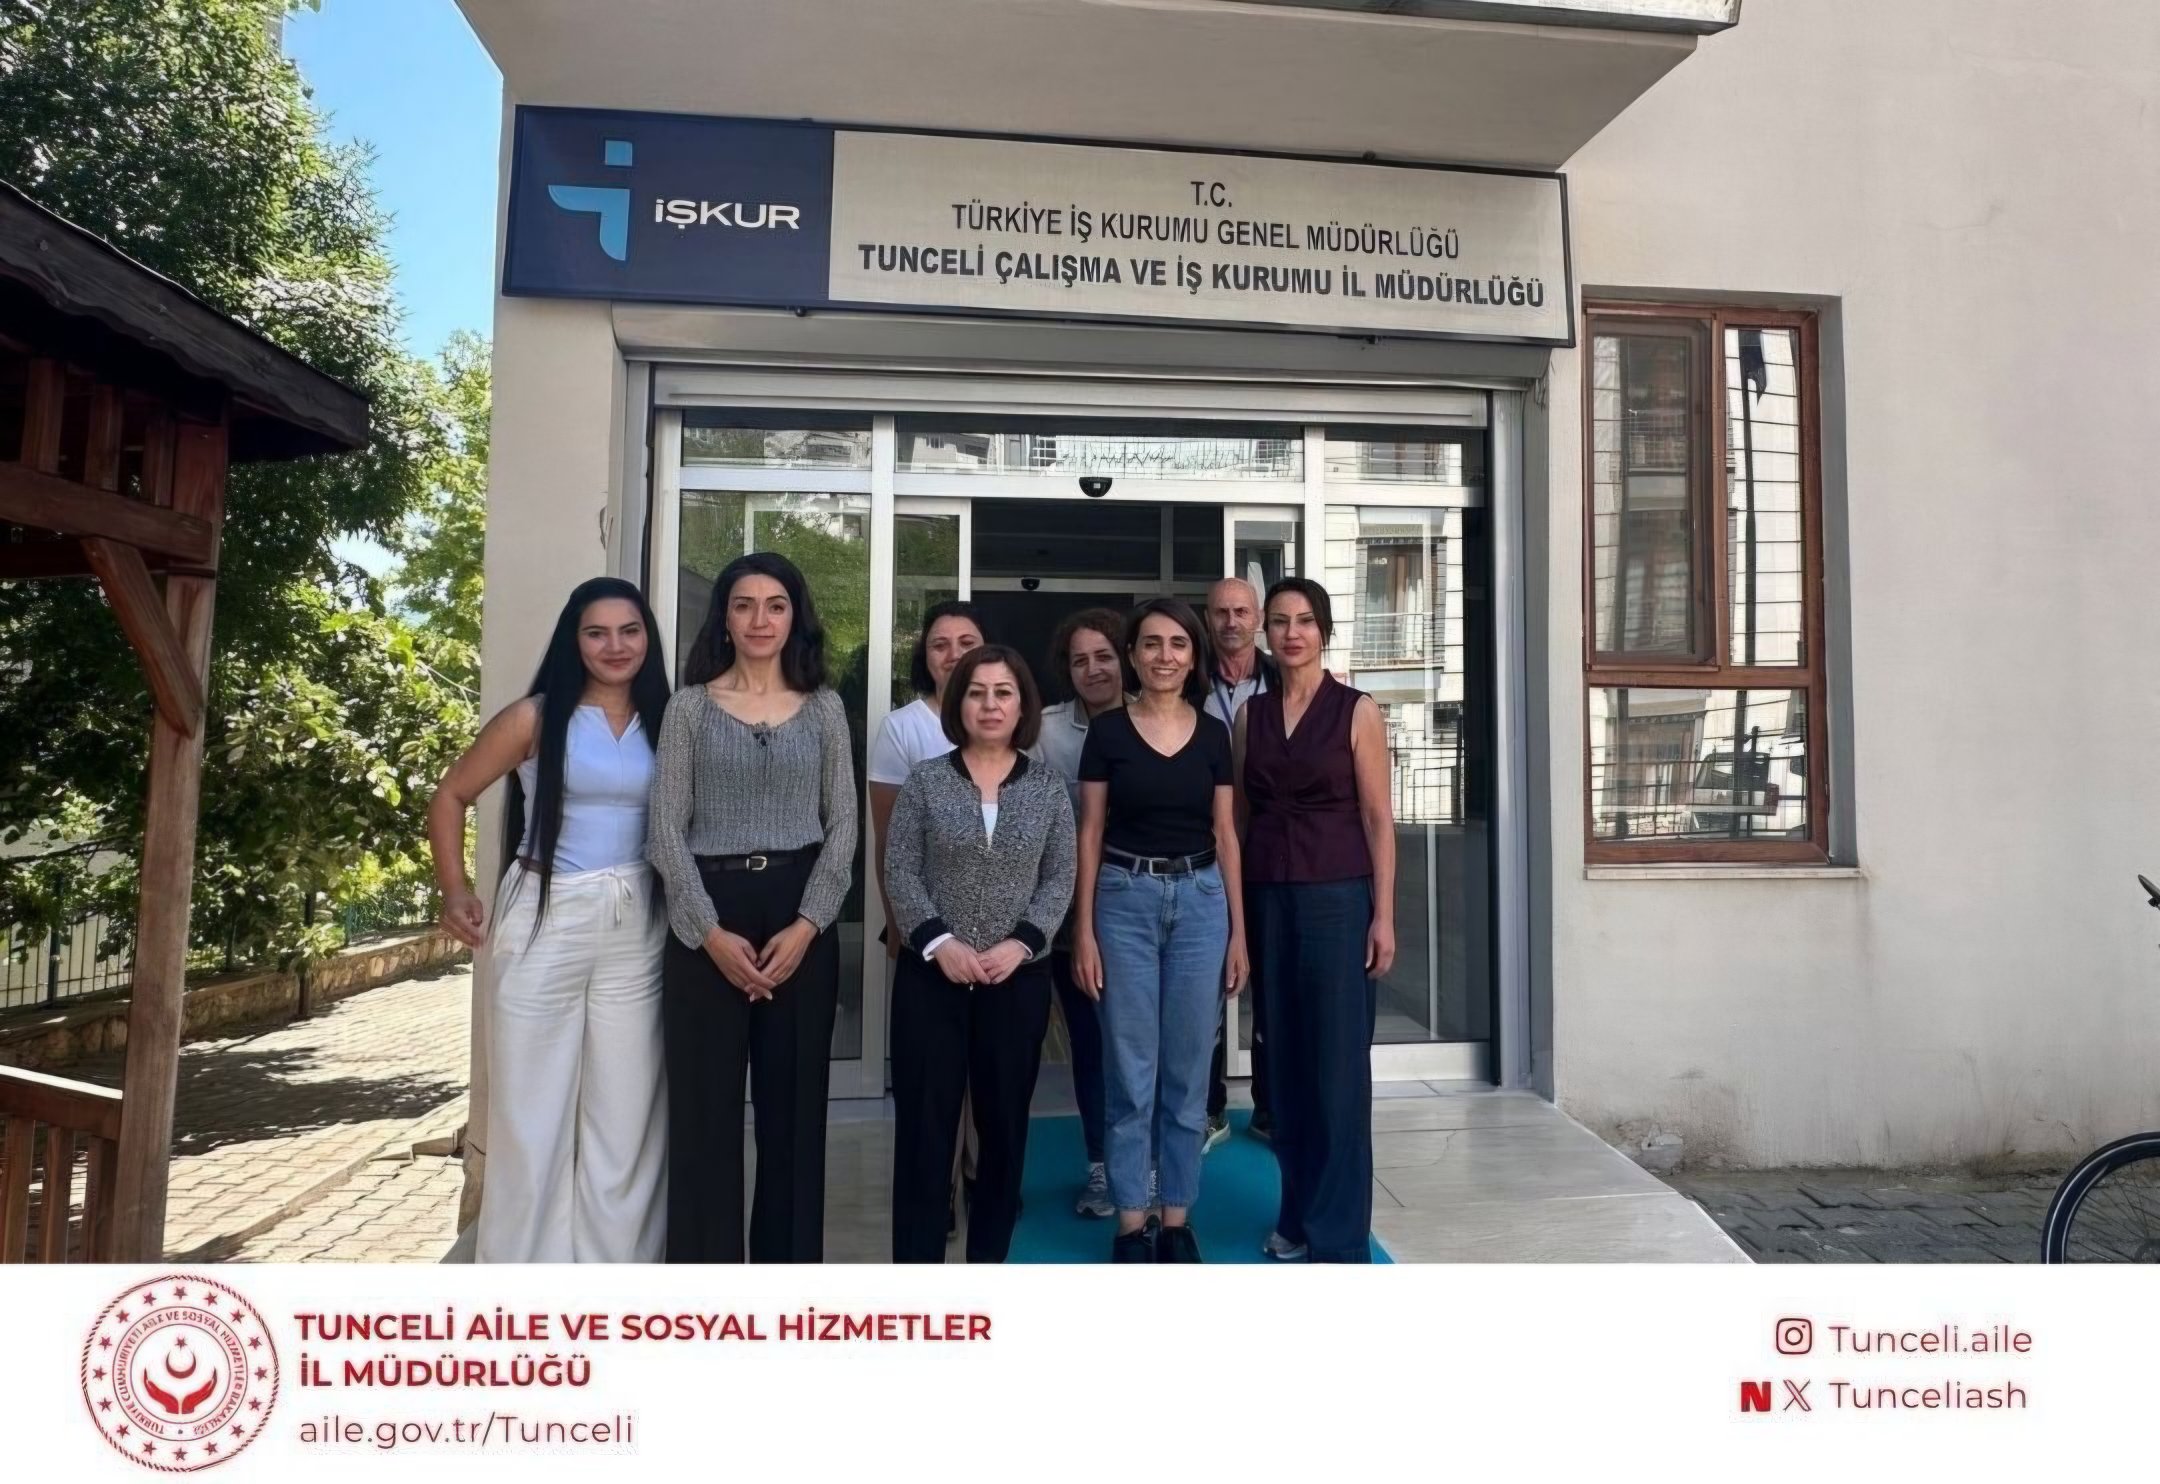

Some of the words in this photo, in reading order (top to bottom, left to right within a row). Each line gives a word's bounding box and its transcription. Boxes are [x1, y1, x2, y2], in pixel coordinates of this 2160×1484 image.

[1190, 180, 1234, 208] T.C.
[952, 198, 1063, 235] TÜRKİYE
[1071, 203, 1093, 243] İŞ
[1102, 212, 1208, 243] KURUMU
[1218, 220, 1300, 249] GENEL
[1307, 220, 1459, 259] MÜDÜRLÜĞÜ
[858, 243, 984, 277] TUNCELİ
[995, 251, 1122, 288] ÇALIŞMA
[1130, 258, 1167, 286] VE
[1177, 254, 1203, 295] İŞ
[1213, 263, 1332, 296] KURUMU
[1343, 264, 1367, 297] İL
[1376, 269, 1544, 308] MÜDÜRLÜĞÜ
